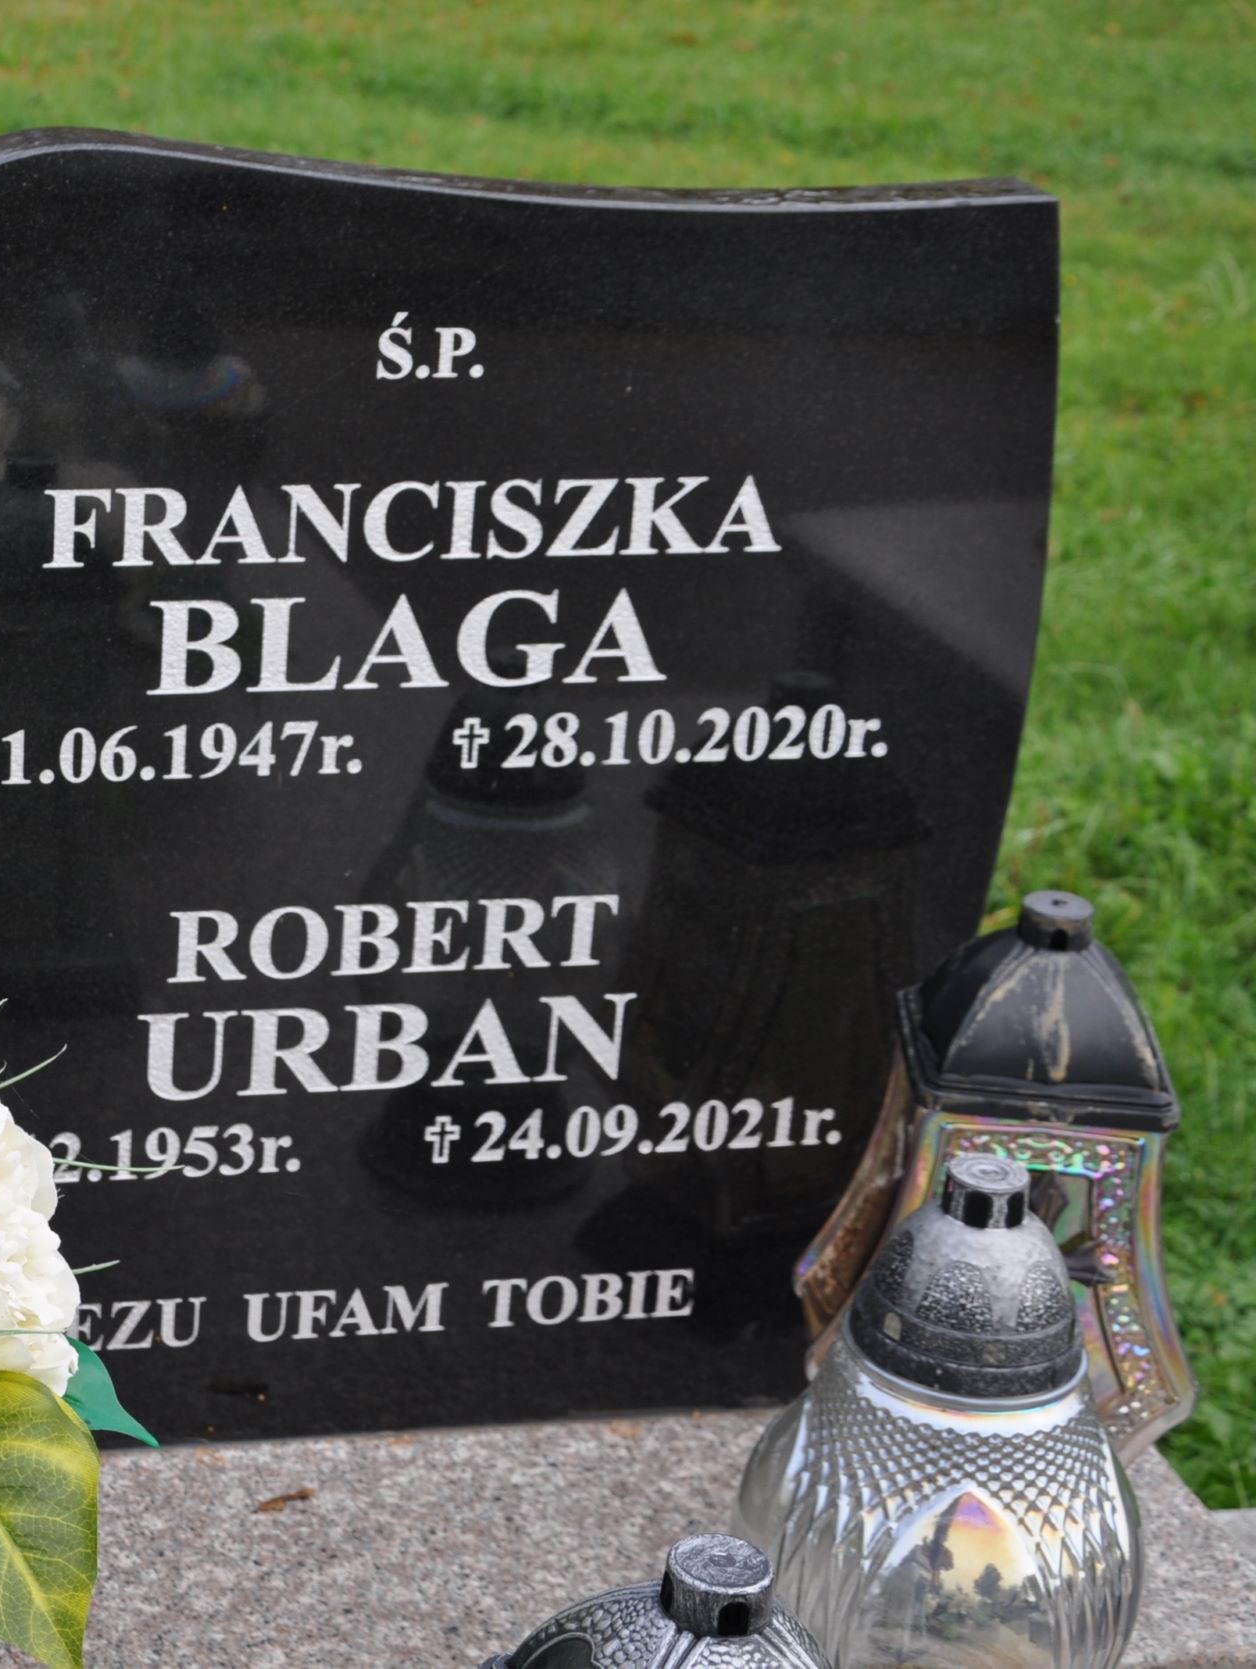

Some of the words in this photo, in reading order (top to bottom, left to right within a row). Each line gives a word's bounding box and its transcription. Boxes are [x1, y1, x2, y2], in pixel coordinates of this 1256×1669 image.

[375, 311, 485, 381] Ś.P.
[42, 475, 783, 569] FRANCISZKA
[145, 588, 668, 696] BLAGA
[500, 703, 888, 769] 28.10.2020r.
[166, 893, 620, 984] ROBERT
[137, 992, 638, 1102] URBAN
[30, 1123, 301, 1184] 2.1953r.
[471, 1097, 841, 1163] 24.09.2021r.
[66, 1296, 208, 1352] EZU
[243, 1282, 449, 1343] UFAM
[482, 1268, 697, 1328] TOBIE
